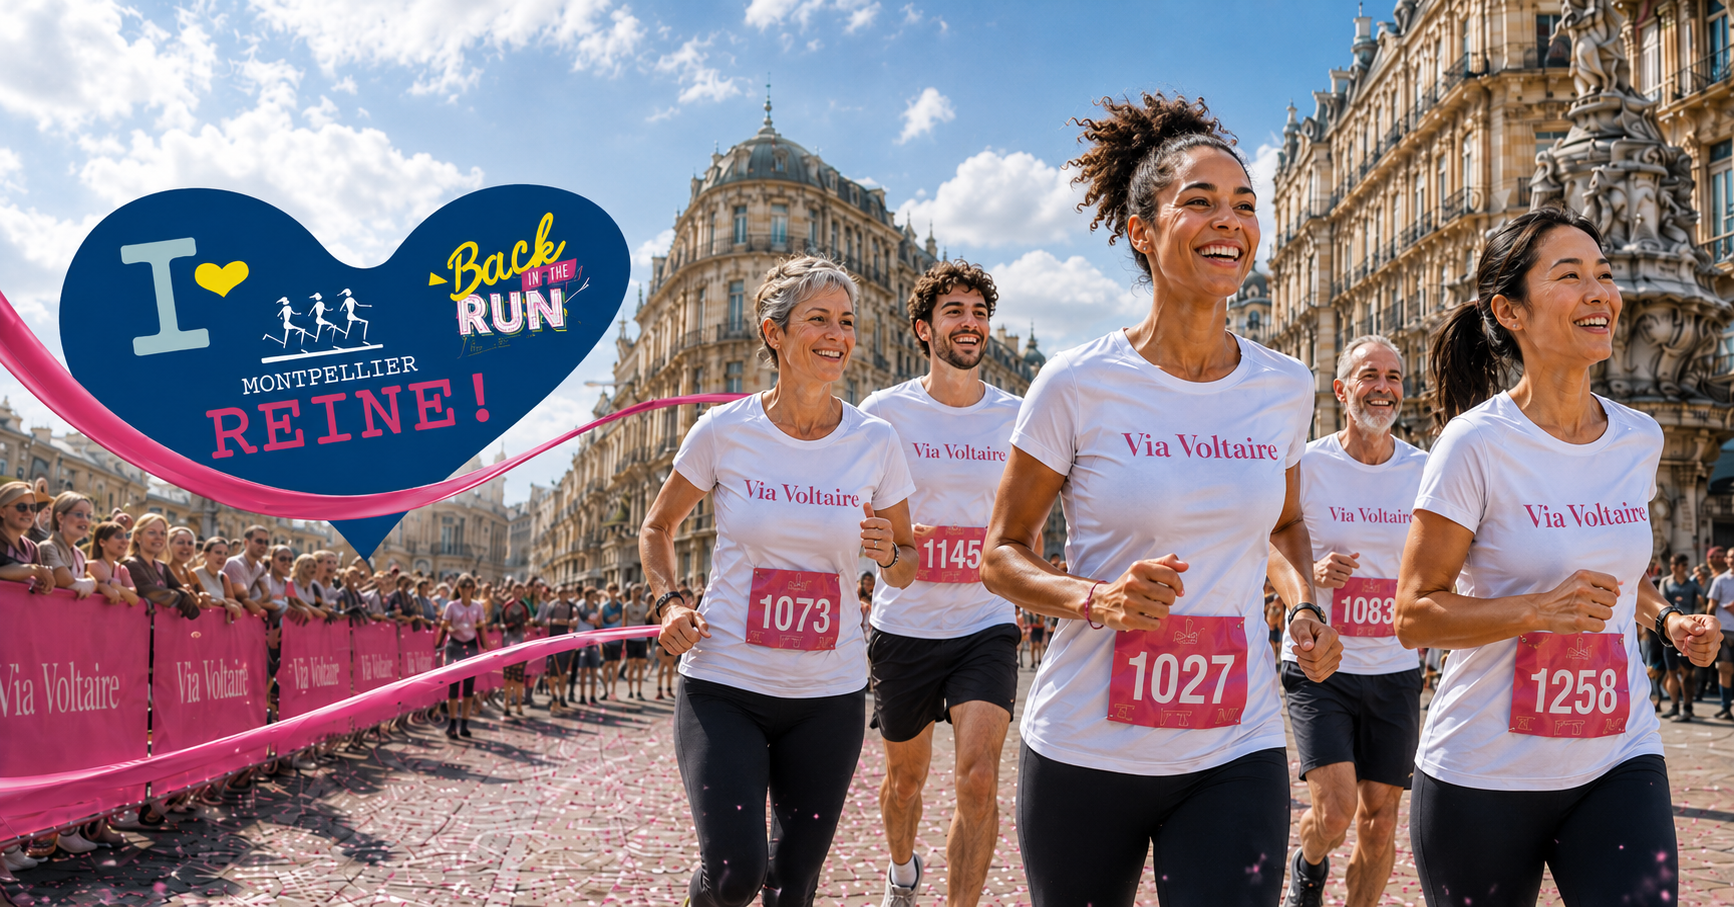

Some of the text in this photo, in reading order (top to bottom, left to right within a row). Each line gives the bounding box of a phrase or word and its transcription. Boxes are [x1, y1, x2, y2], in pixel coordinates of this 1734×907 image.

[447, 212, 566, 301] Back
[528, 263, 569, 286] IN THE
[120, 237, 210, 356] I
[456, 288, 567, 336] RUN
[241, 355, 418, 395] MONTPELLIER
[912, 442, 1006, 462] Via Voltaire
[1121, 432, 1278, 461] Via Voltaire
[744, 479, 860, 508] Via Voltaire
[1328, 506, 1355, 523] Via
[1523, 501, 1647, 529] Via Voltaire
[923, 538, 981, 570] 1145
[759, 594, 831, 634] 1073
[1341, 595, 1395, 625] 1083
[0, 661, 121, 718] Via Voltaire
[176, 658, 249, 704] Via Voltaire
[293, 657, 309, 690] Via
[1128, 651, 1235, 704] 1027
[1530, 667, 1618, 715] 1258
